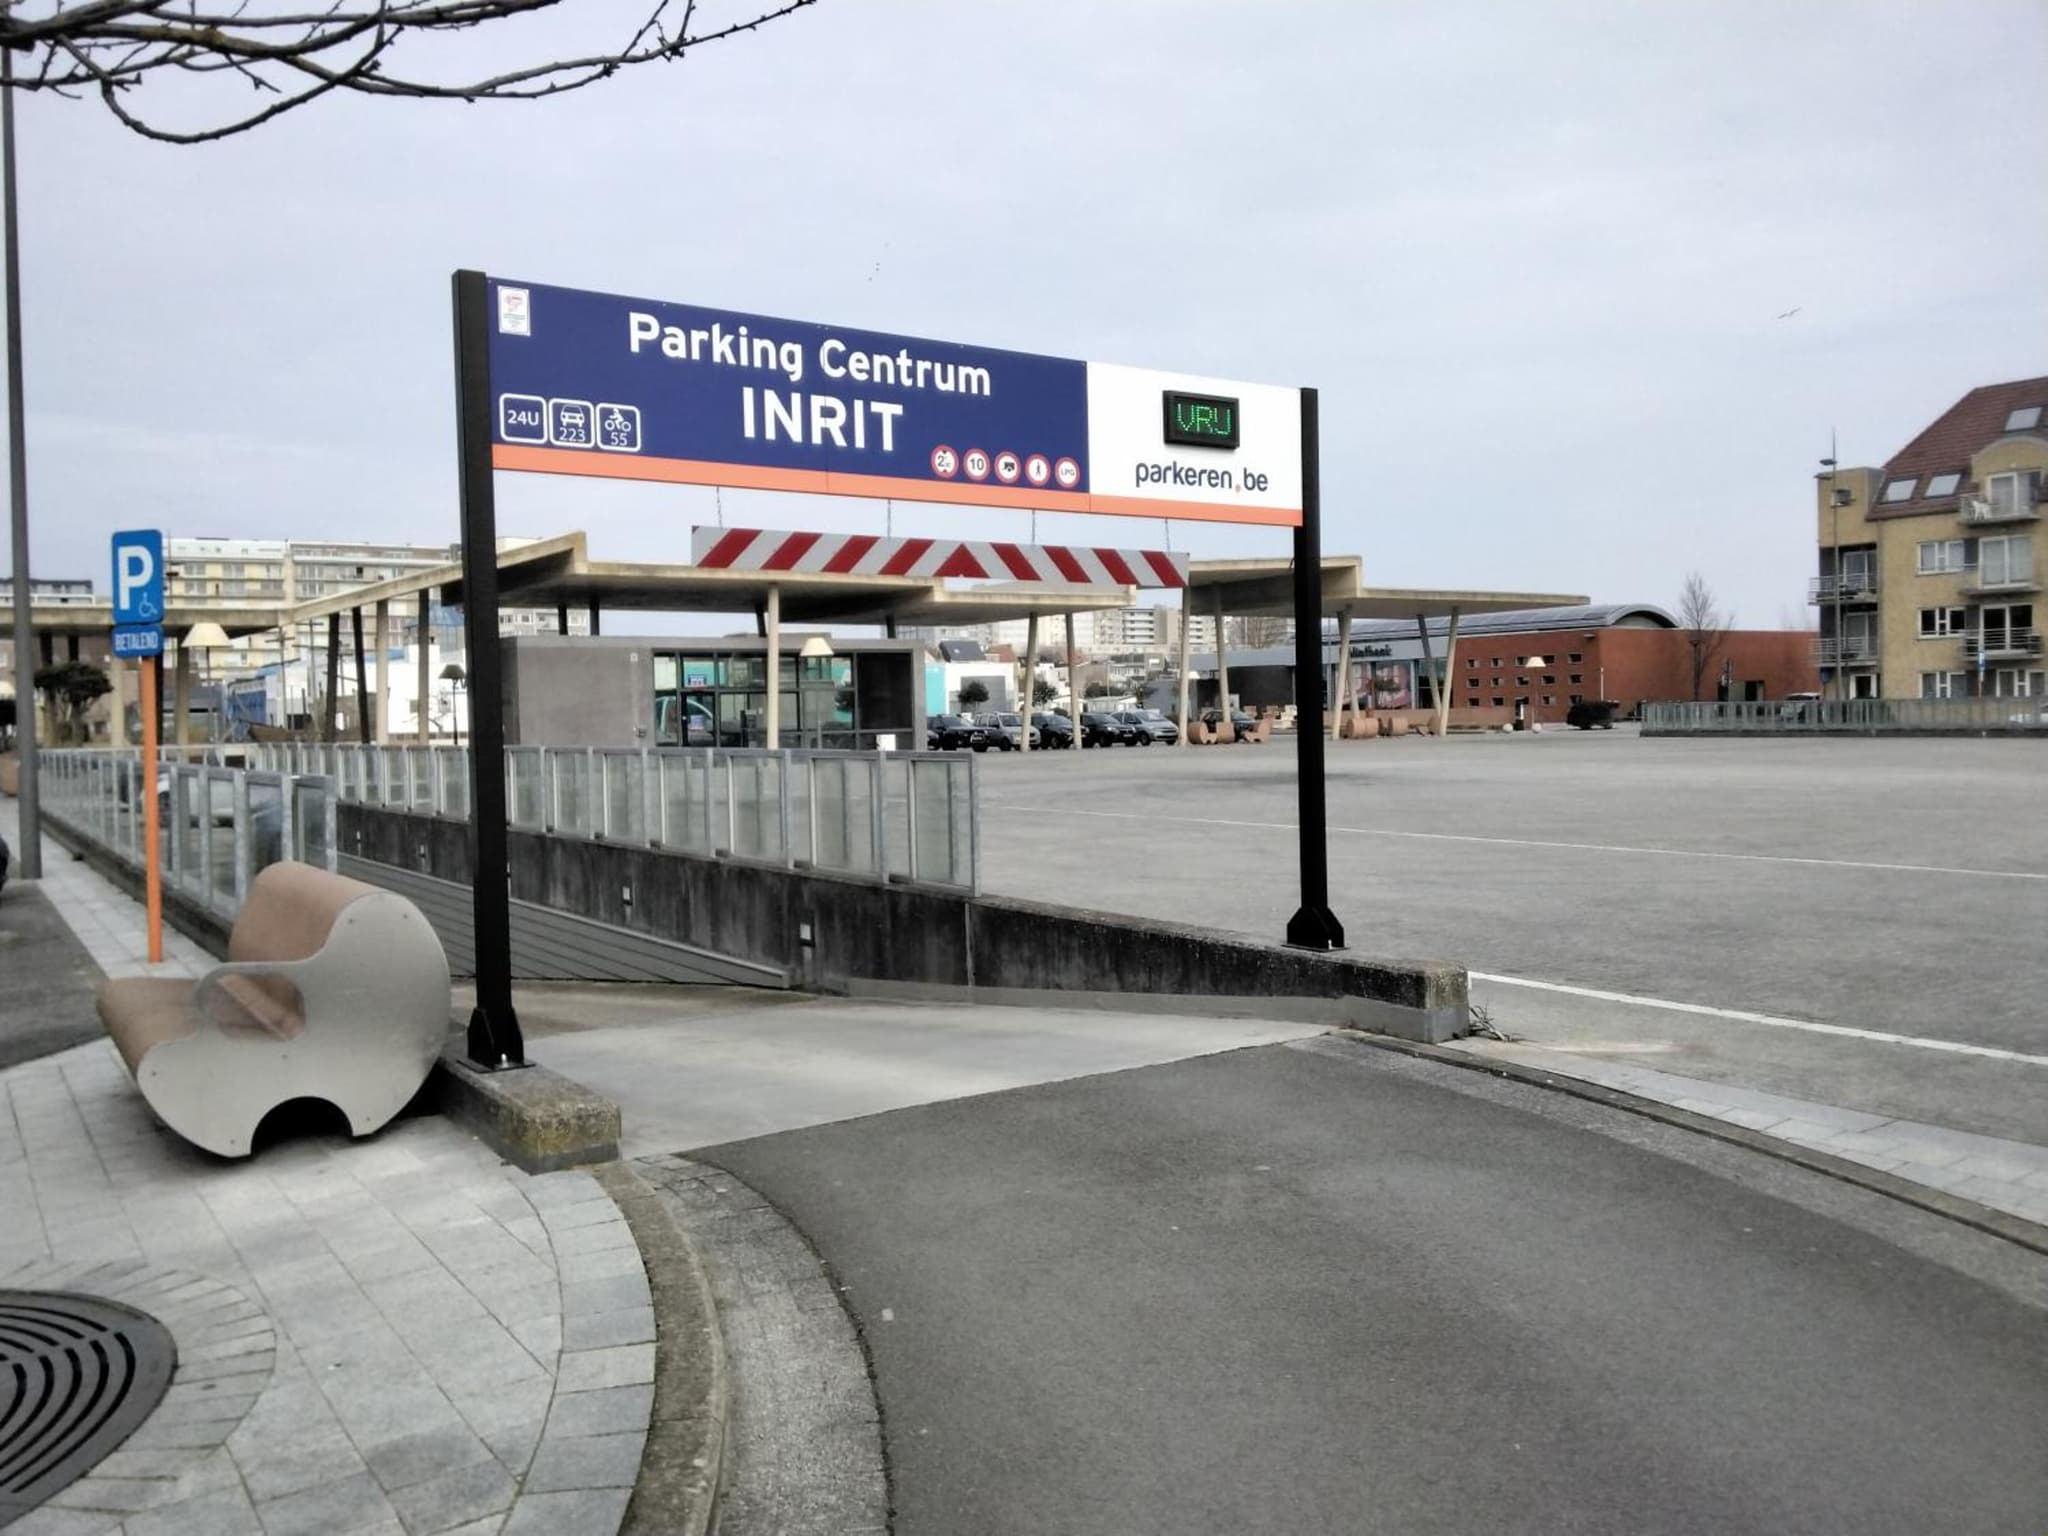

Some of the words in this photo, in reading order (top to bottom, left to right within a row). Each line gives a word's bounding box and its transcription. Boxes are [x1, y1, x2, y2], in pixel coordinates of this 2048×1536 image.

[629, 311, 803, 382] Parking
[819, 339, 991, 396] Centrum
[507, 409, 539, 426] 24U
[742, 386, 903, 451] INRIT
[559, 427, 586, 442] 223
[610, 431, 628, 446] 55
[969, 458, 985, 471] 10
[1135, 460, 1269, 492] parkeren.be
[118, 545, 154, 611] P
